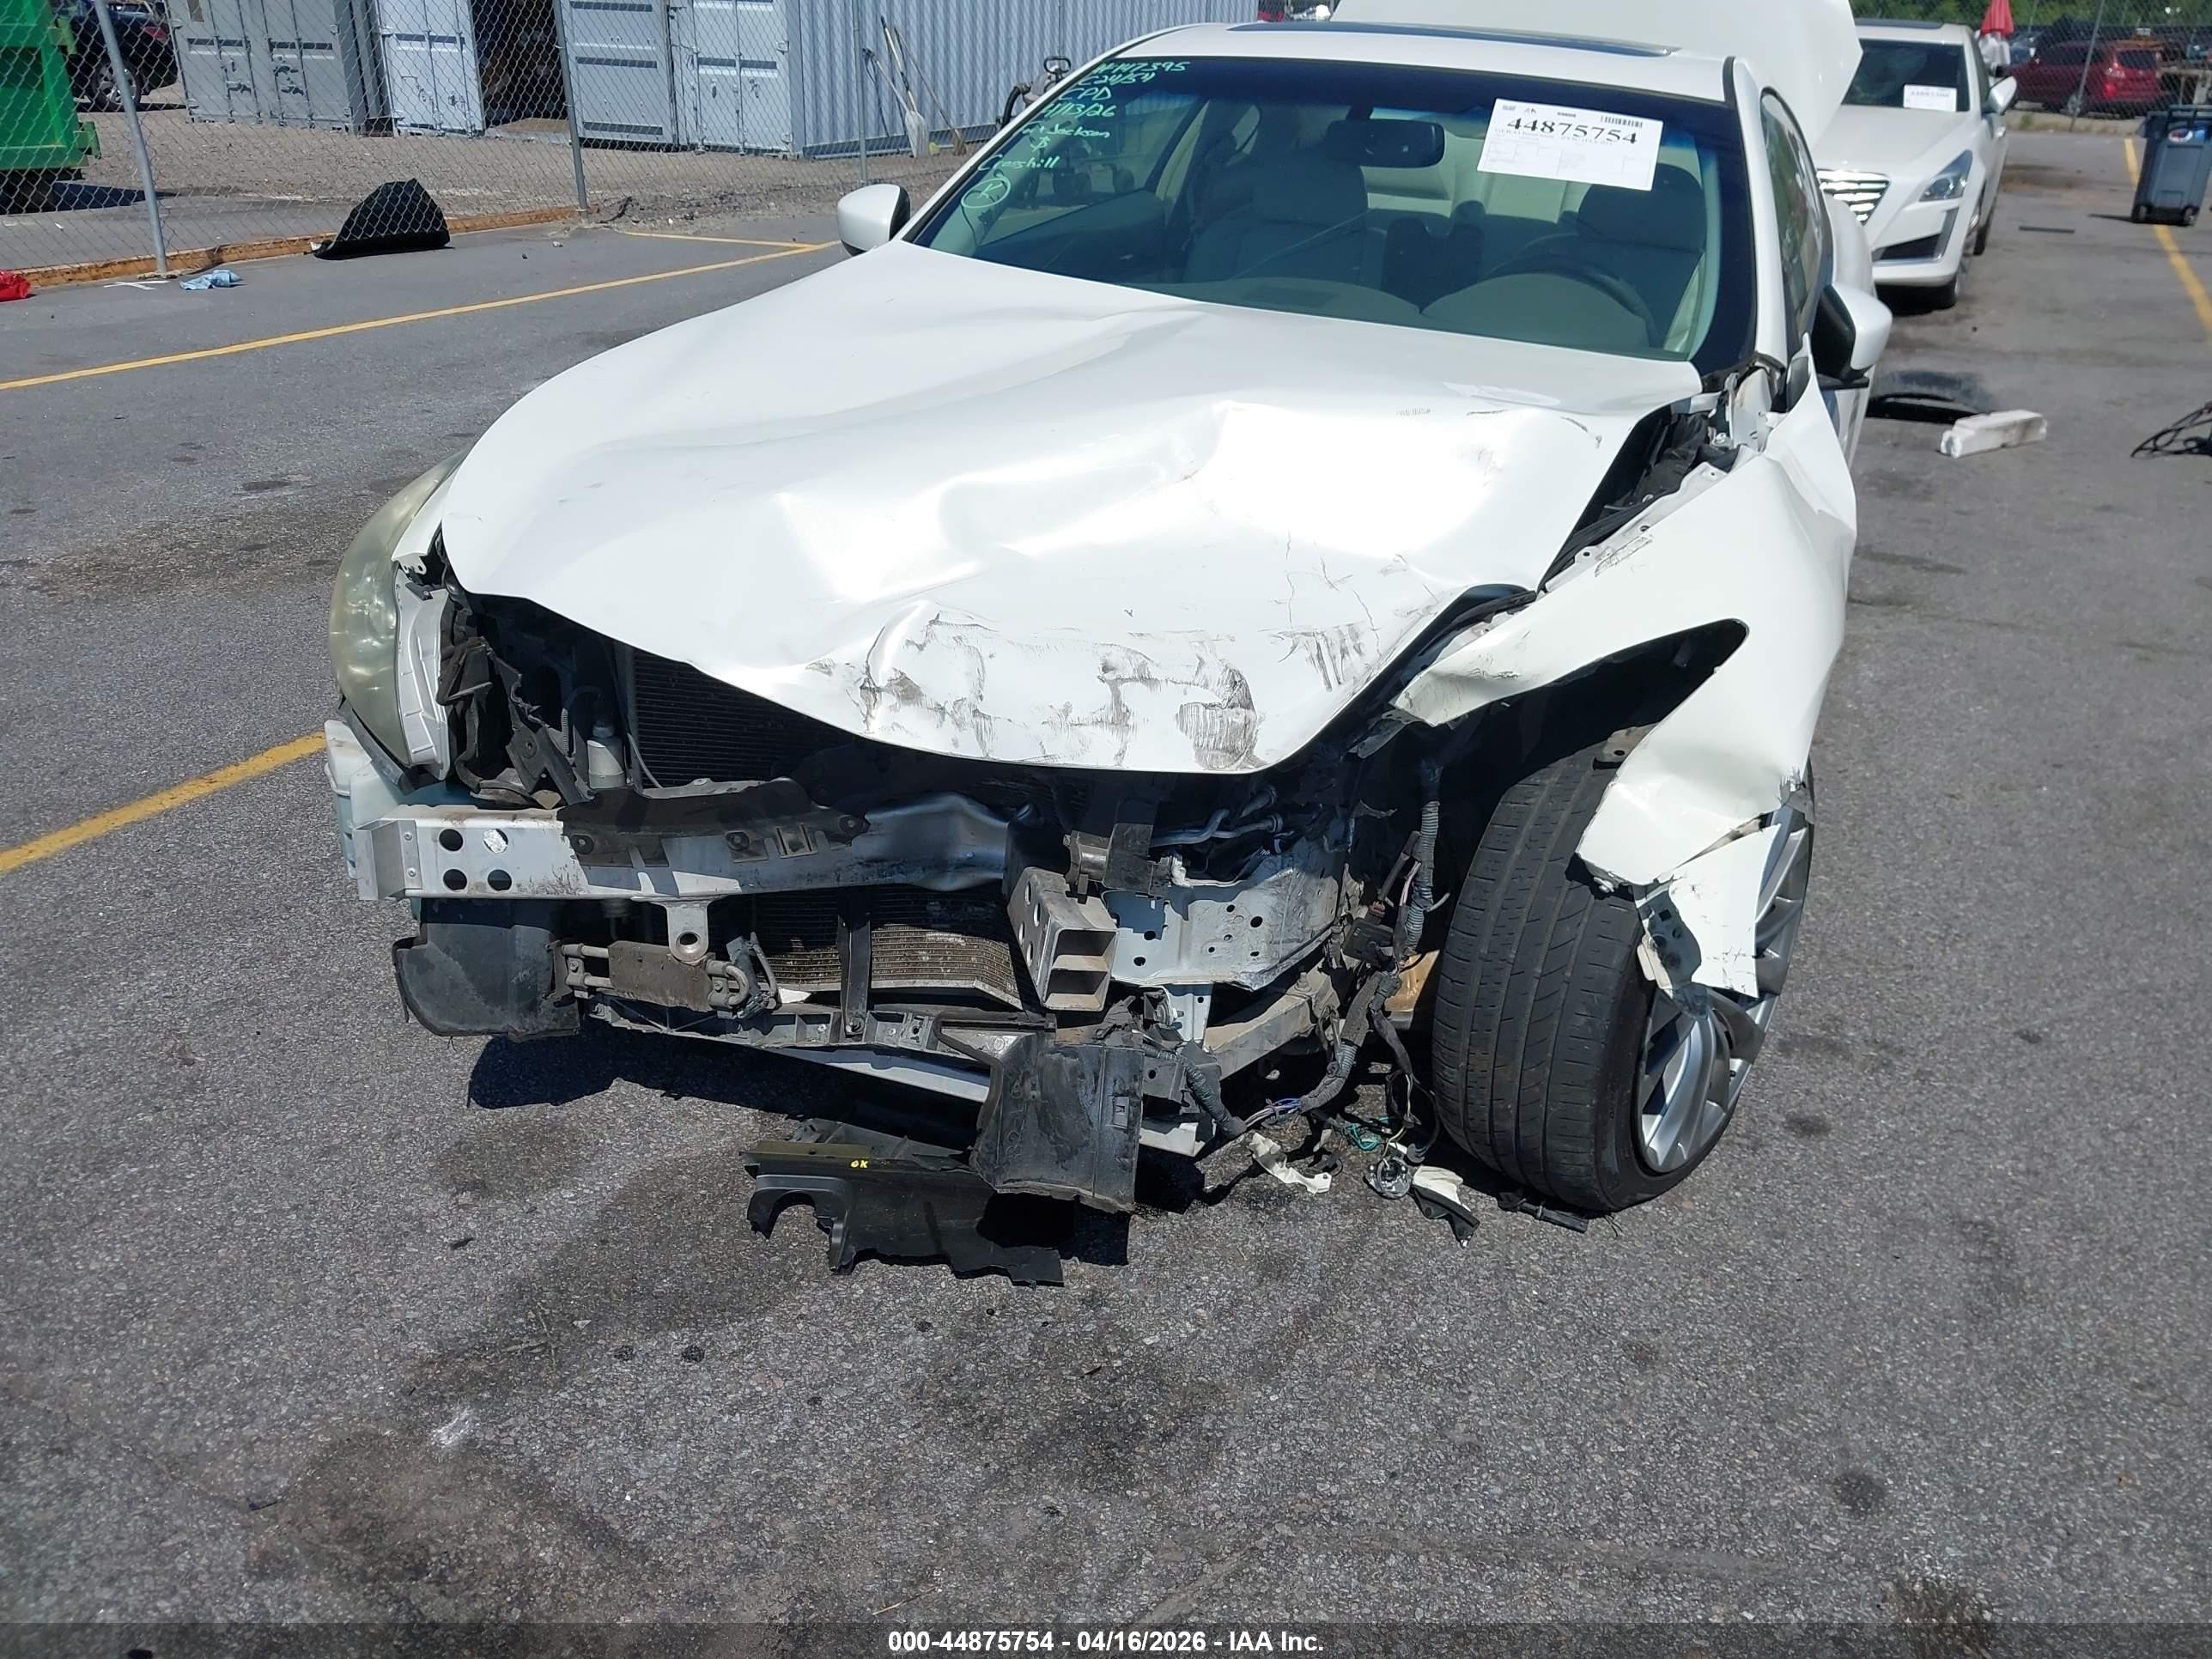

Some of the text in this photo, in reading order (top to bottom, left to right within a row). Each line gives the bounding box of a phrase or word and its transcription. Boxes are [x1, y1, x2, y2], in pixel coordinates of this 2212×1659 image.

[1059, 87, 1112, 100] CPD
[1042, 102, 1116, 118] 4/13/26
[1507, 116, 1638, 144] 44875754
[850, 1159, 868, 1169] OK
